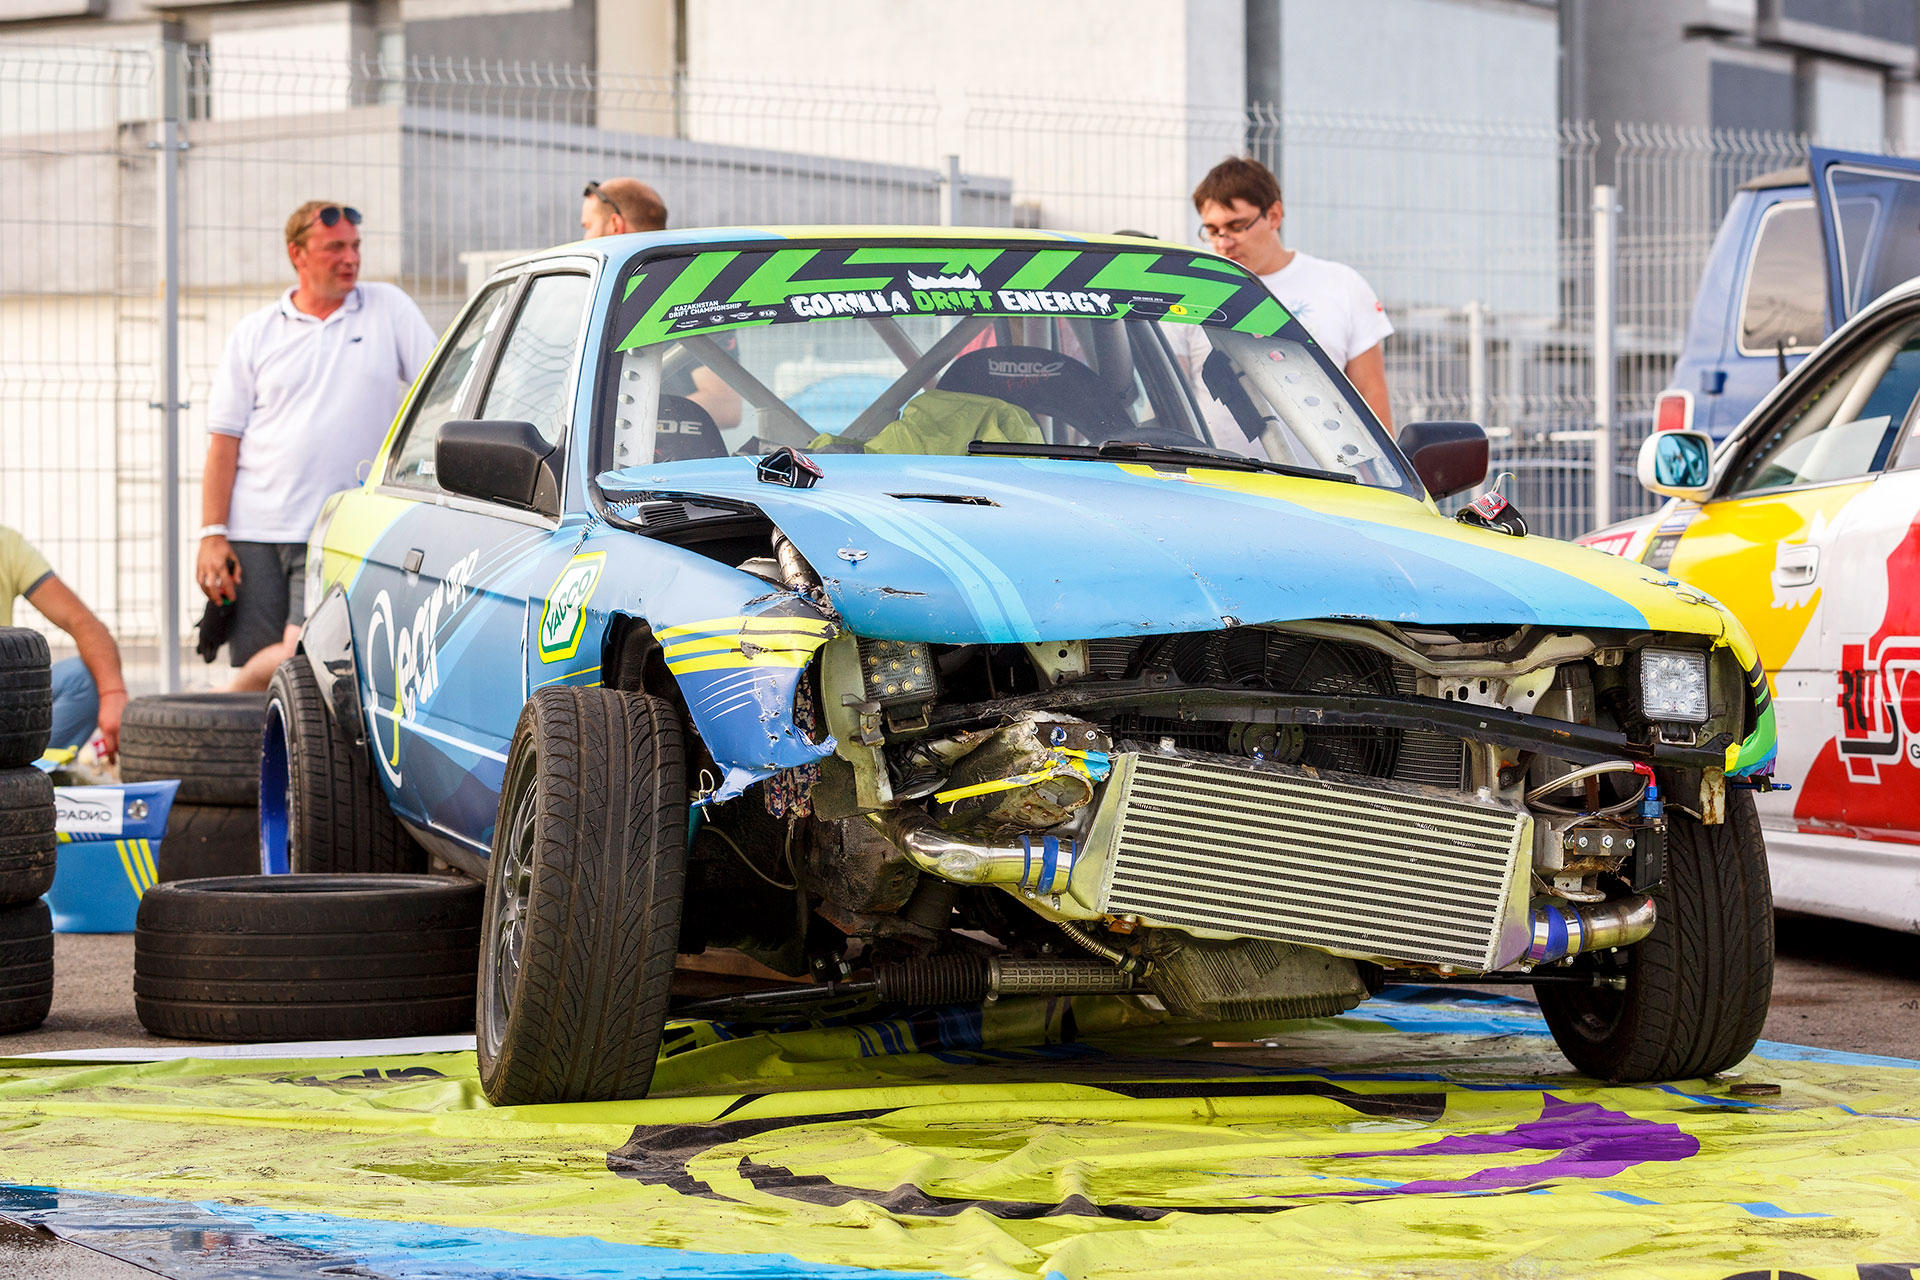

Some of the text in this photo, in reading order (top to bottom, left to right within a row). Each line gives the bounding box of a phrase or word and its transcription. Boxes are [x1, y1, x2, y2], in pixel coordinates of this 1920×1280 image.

[668, 303, 742, 319] DRIFT CHAMPIONSHIP
[674, 300, 719, 312] KAZAKHSTAN
[790, 289, 1112, 317] GORILLA DRIFT ENERGY
[546, 569, 591, 640] YACCO
